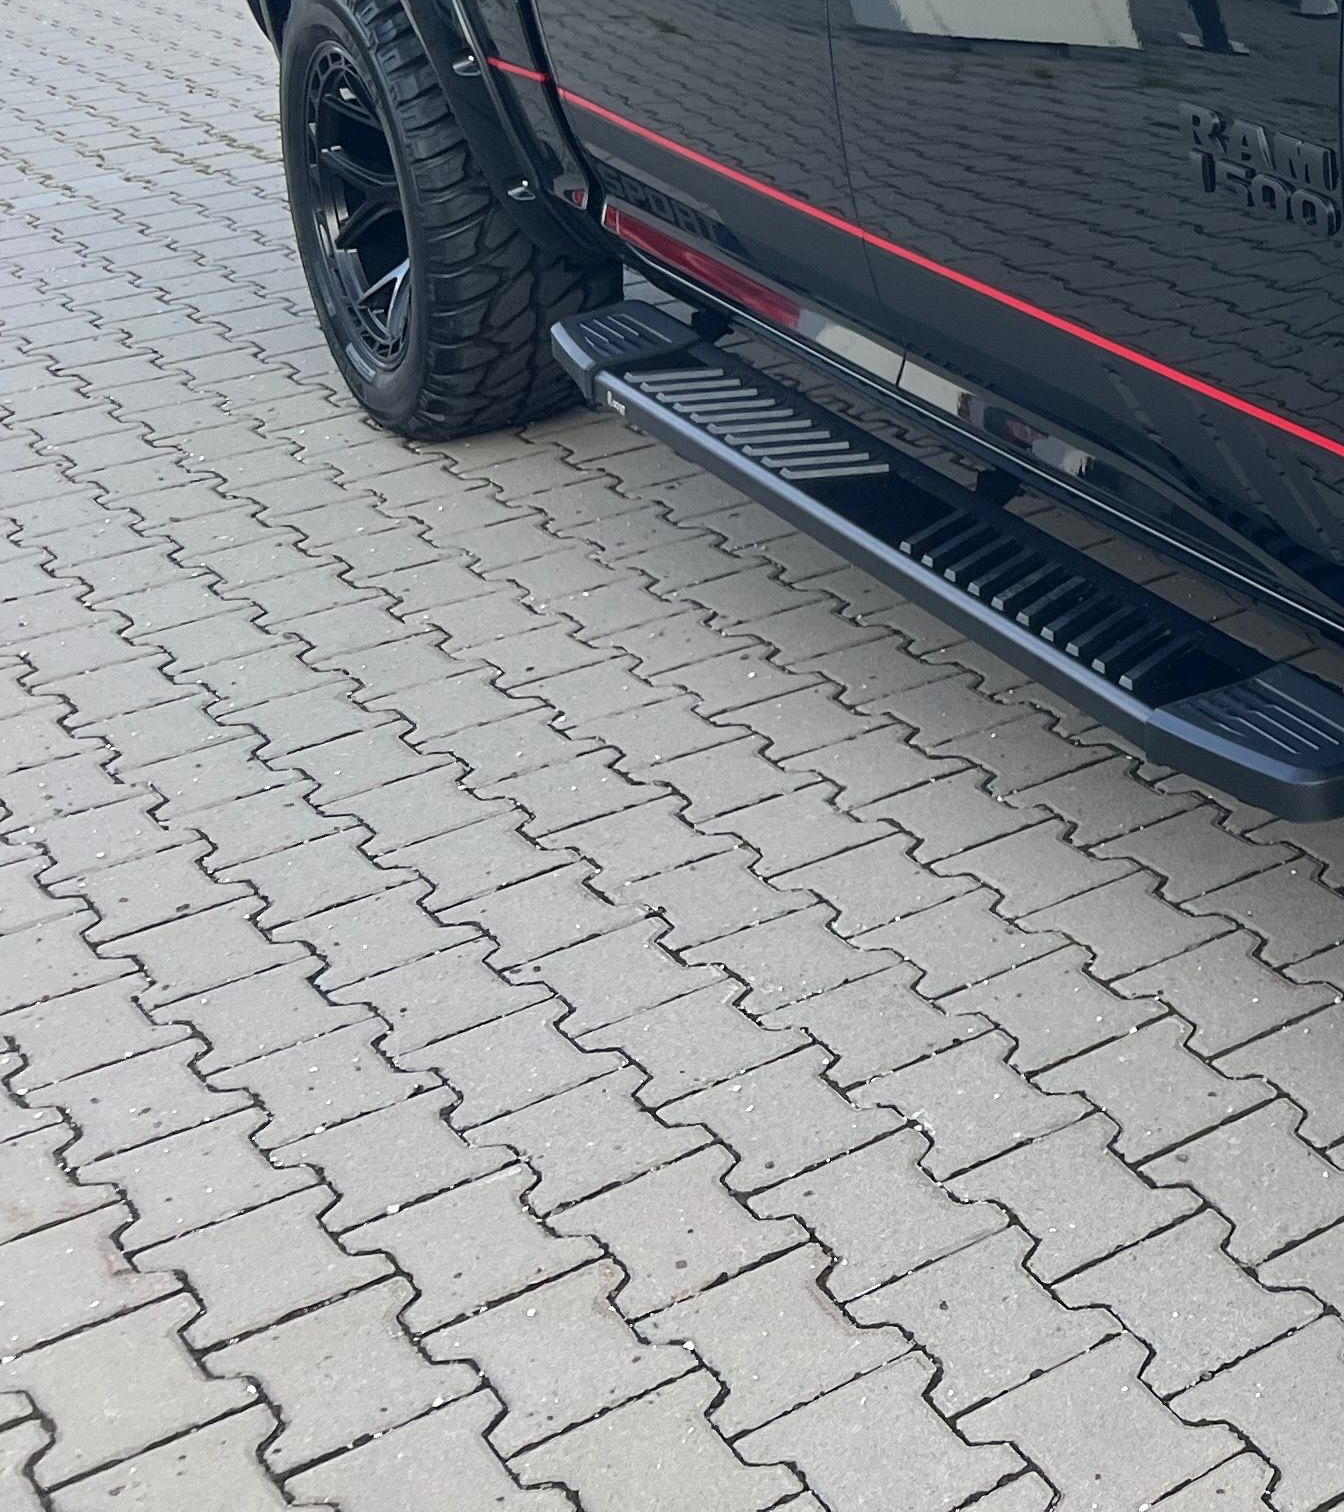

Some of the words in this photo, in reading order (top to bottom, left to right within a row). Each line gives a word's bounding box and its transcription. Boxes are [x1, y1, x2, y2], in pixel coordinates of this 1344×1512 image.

[1178, 101, 1338, 190] RAM
[597, 167, 721, 245] SPORT
[1189, 149, 1341, 237] 1500
